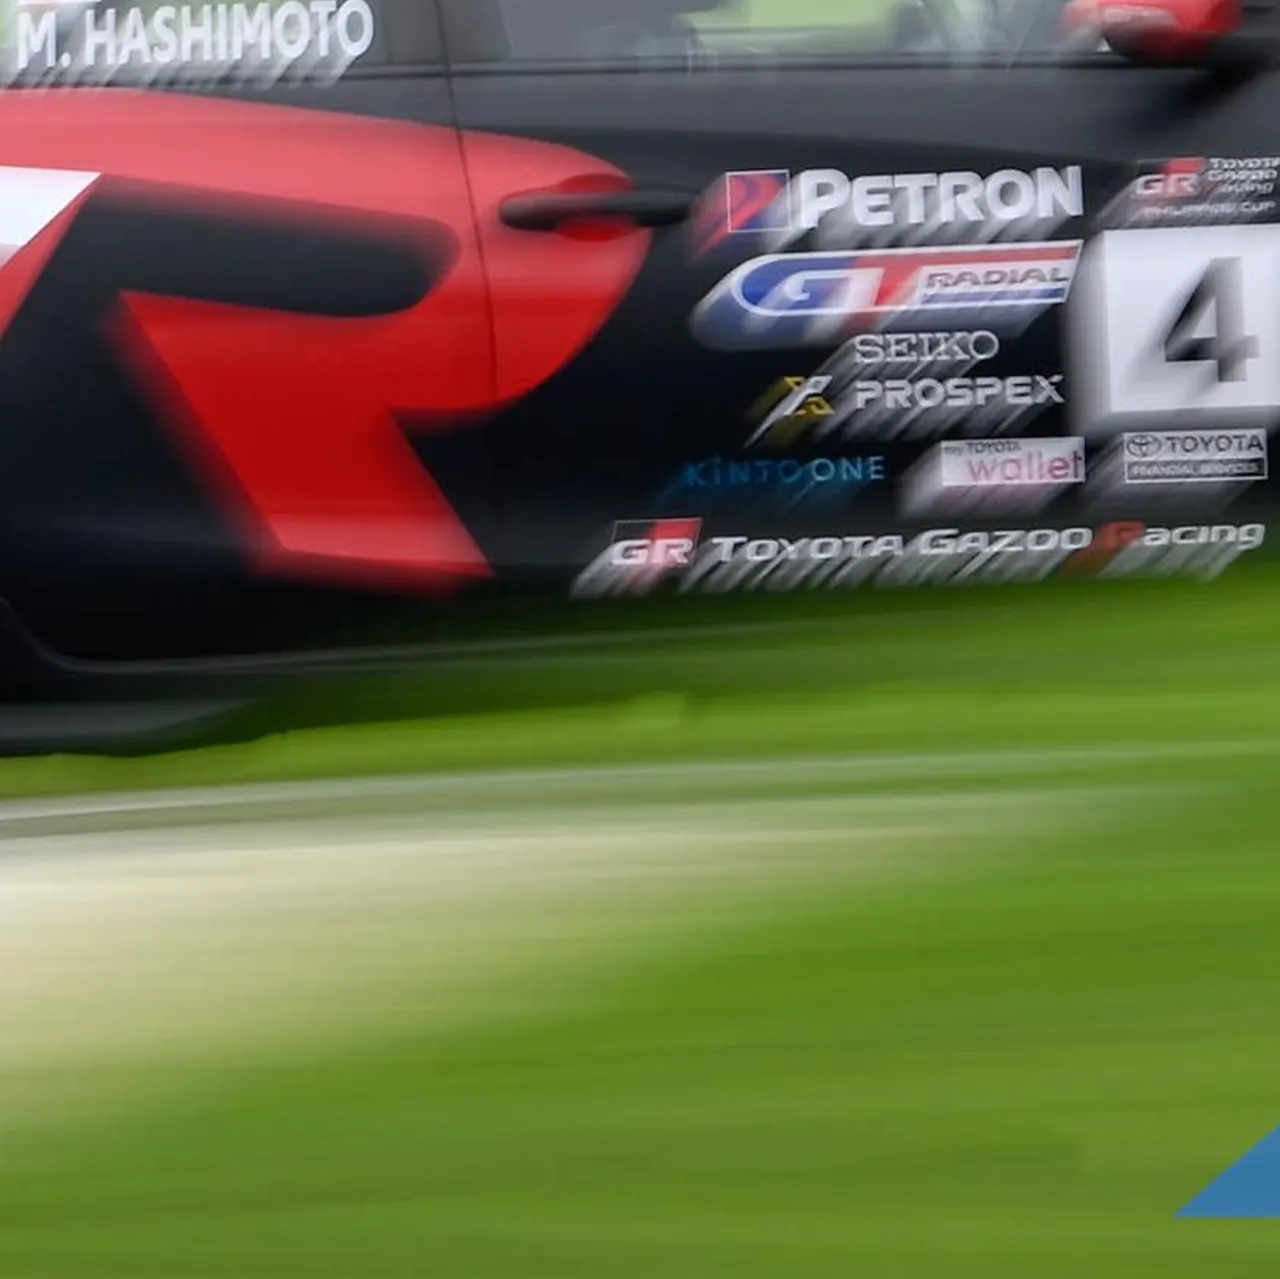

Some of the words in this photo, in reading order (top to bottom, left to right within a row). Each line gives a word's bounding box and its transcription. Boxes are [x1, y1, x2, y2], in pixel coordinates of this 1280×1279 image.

[18, 11, 71, 69] M.
[792, 165, 1084, 228] PETRON
[1134, 173, 1201, 195] GR
[923, 269, 1068, 288] RADIAL
[1163, 257, 1261, 383] 4
[853, 331, 999, 364] SEIKO
[855, 376, 1064, 409] PROSPEX
[1166, 434, 1265, 453] TOYOTA
[808, 457, 885, 482] ONE
[969, 451, 1082, 481] wallet
[613, 537, 691, 564] GR
[1100, 521, 1265, 550] Racing
